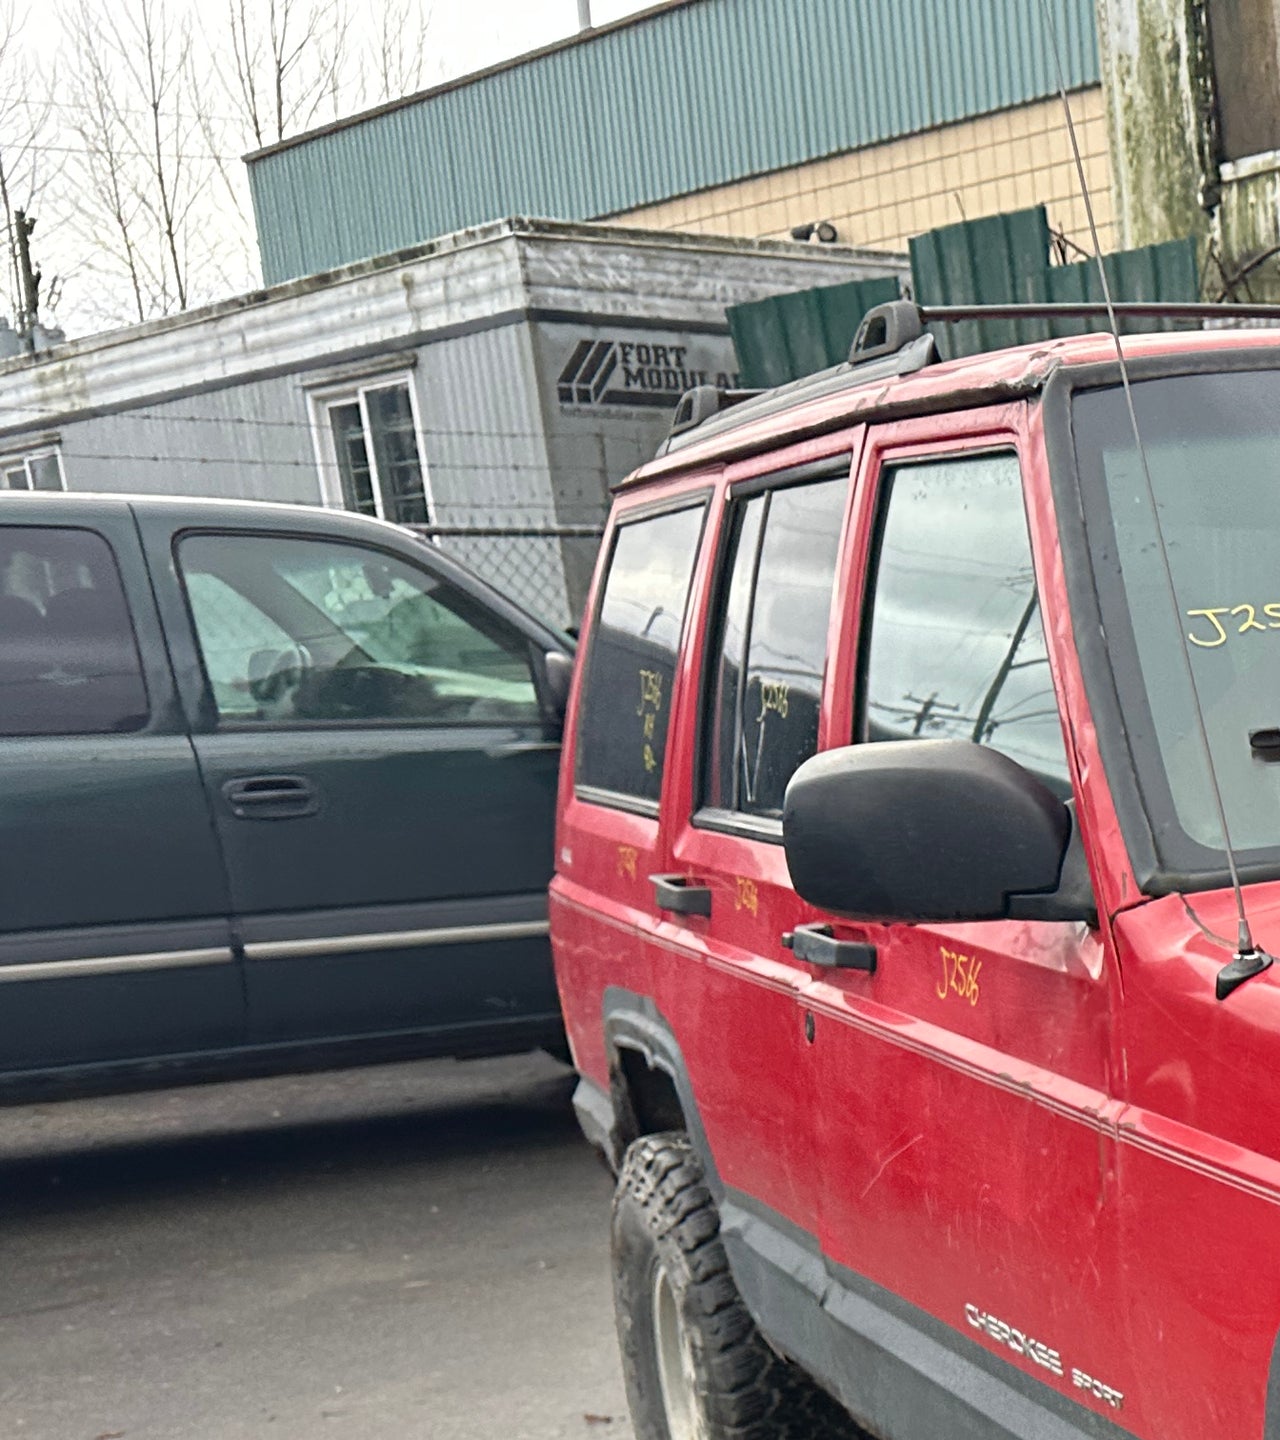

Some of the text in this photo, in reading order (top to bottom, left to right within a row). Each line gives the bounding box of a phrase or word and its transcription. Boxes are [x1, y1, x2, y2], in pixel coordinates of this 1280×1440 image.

[619, 341, 687, 367] FORT
[936, 946, 982, 1007] J2566
[965, 1302, 1124, 1411] CHEROKEE SPORT
